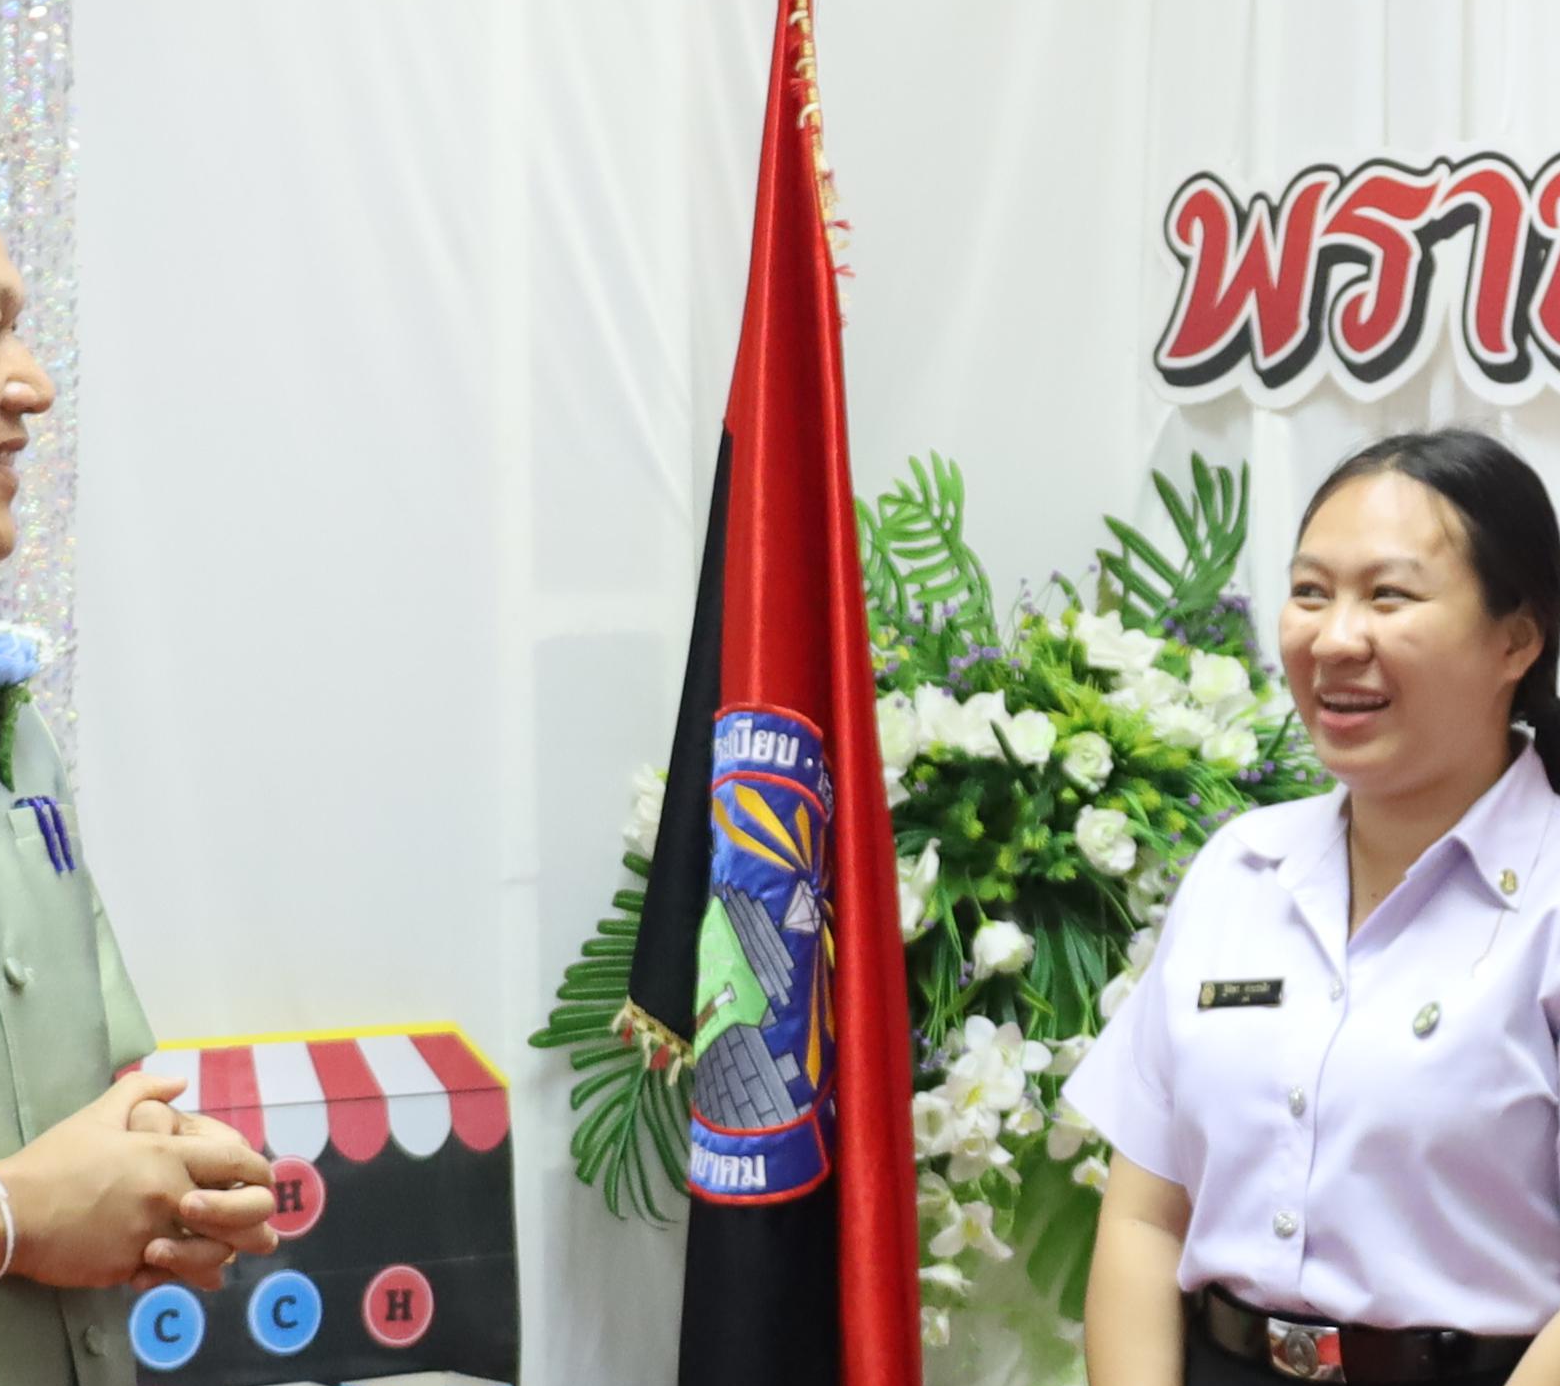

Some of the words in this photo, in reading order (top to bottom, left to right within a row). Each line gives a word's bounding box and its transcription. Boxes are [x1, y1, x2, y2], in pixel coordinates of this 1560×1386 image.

[692, 1142, 766, 1189] ยาคม
[275, 1179, 304, 1214] H
[153, 1308, 181, 1343] C
[271, 1294, 298, 1329] C
[384, 1288, 414, 1322] H
